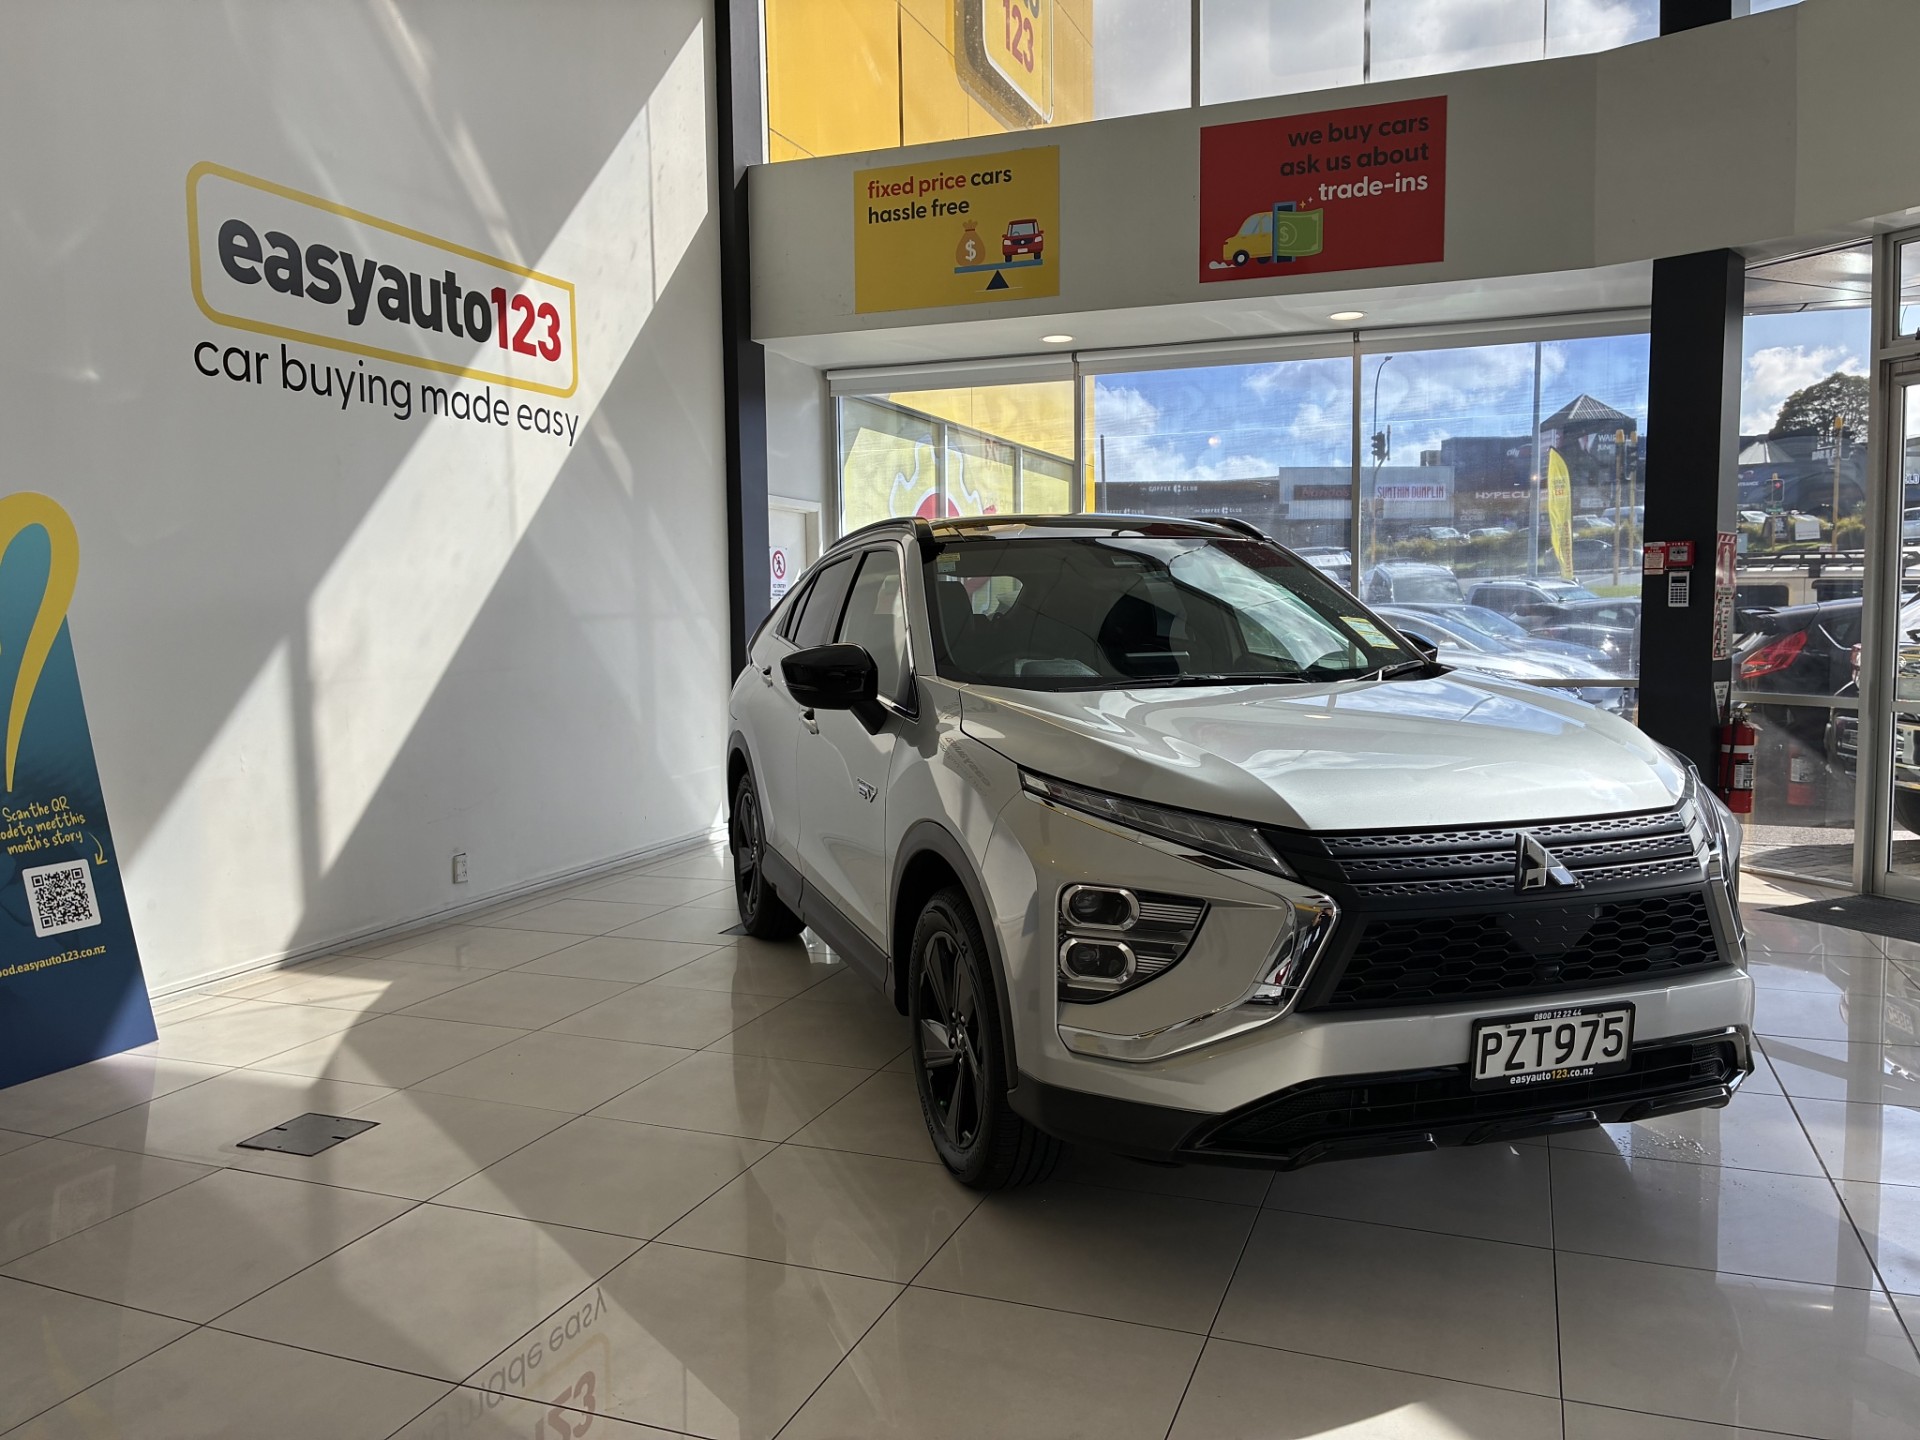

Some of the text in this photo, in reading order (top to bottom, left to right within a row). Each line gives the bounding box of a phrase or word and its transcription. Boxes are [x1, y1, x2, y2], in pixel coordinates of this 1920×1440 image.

[1003, 0, 1034, 74] 123
[1288, 116, 1430, 147] we buy cars
[1280, 143, 1430, 176] ask us about
[868, 169, 1012, 199] fixed price cars
[1318, 172, 1429, 201] trade-ins
[868, 198, 970, 224] hassle free
[217, 218, 562, 362] easyauto123
[194, 341, 579, 447] car buying made easy
[2, 795, 70, 822] Scan the QR
[0, 811, 86, 841] ode to meet this
[7, 829, 83, 856] month's story
[1534, 1008, 1582, 1021] 0800 12 22 44
[1480, 1016, 1624, 1075] PZT975
[1509, 1066, 1594, 1085] easyauto123.co.nz
